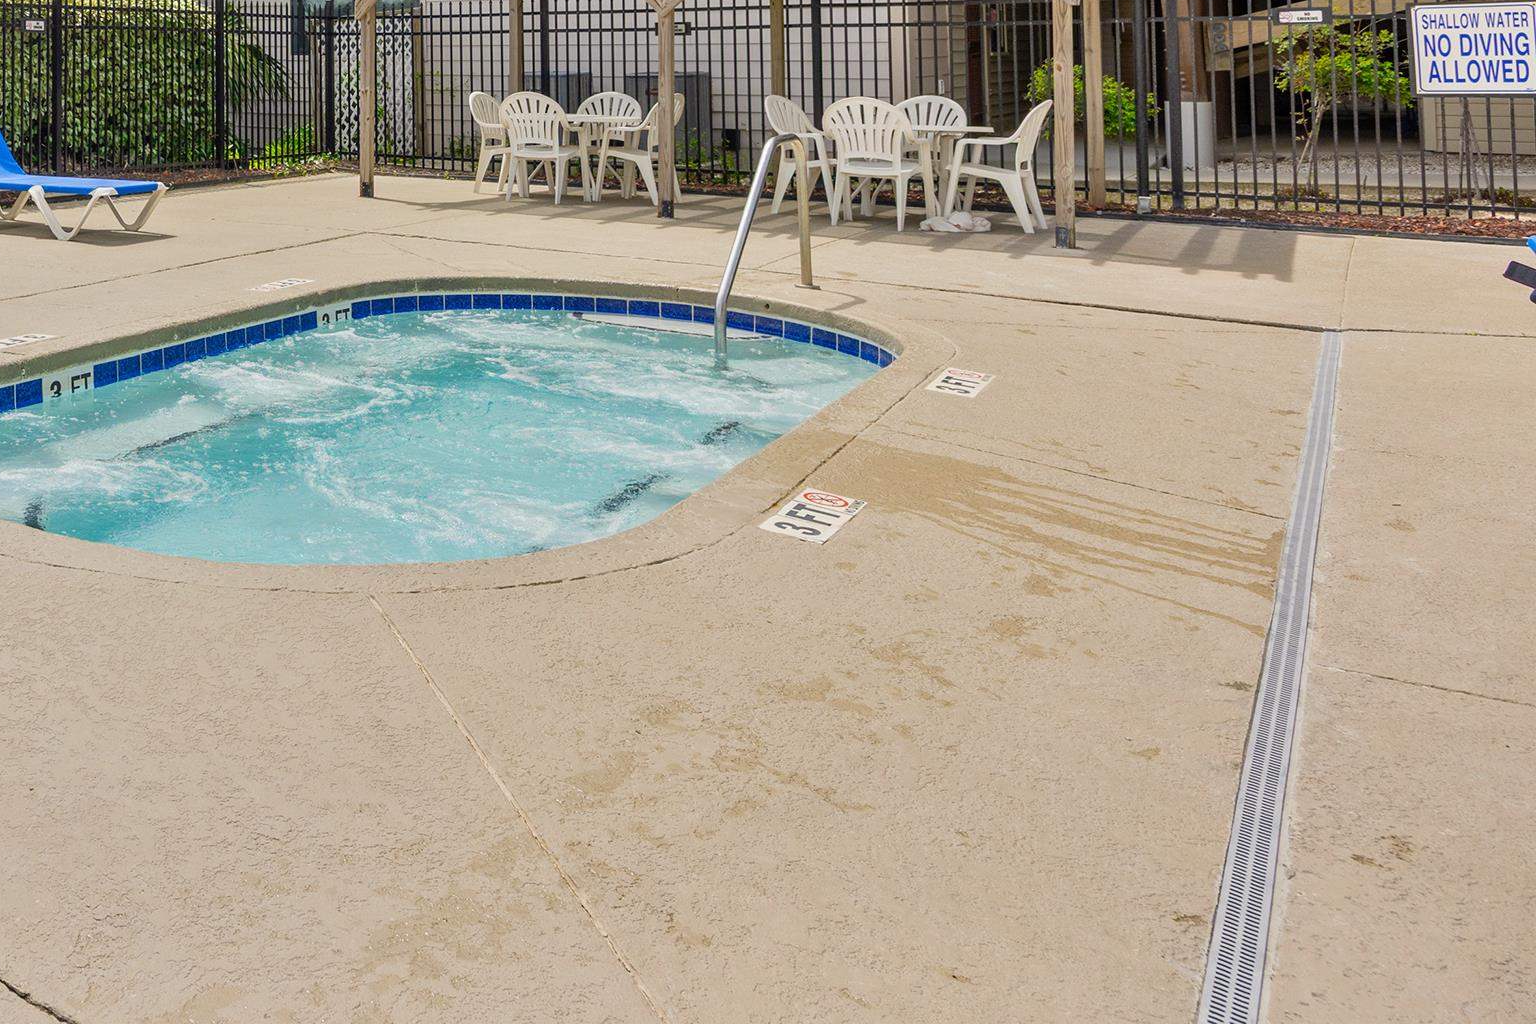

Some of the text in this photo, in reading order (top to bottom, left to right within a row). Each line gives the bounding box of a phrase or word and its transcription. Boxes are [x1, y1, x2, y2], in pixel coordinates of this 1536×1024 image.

[1421, 11, 1529, 30] SHALLOW WATER
[1423, 32, 1530, 57] NO DIVING
[1428, 59, 1530, 83] ALLOWED
[70, 372, 92, 394] FT
[935, 385, 971, 394] 3
[941, 375, 981, 389] FT
[785, 503, 841, 527] FT
[774, 521, 822, 536] 3
